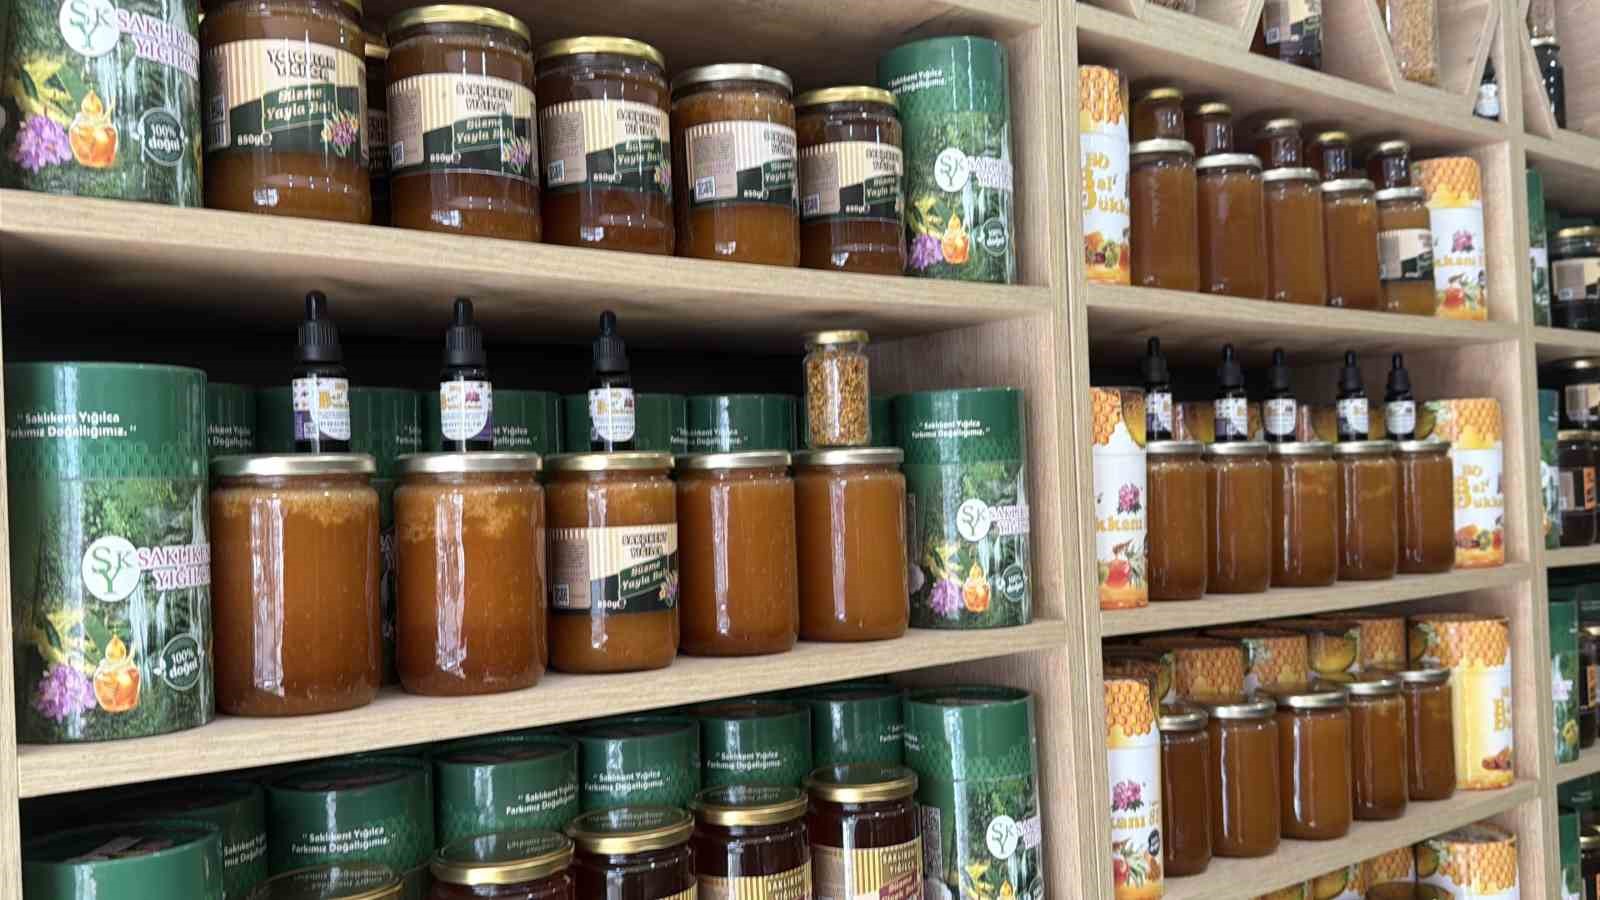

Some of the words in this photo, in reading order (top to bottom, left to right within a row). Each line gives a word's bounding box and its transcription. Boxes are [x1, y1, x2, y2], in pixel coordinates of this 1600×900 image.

[79, 411, 120, 425] Yığılca
[171, 648, 195, 664] 100%
[169, 660, 198, 678] doğal
